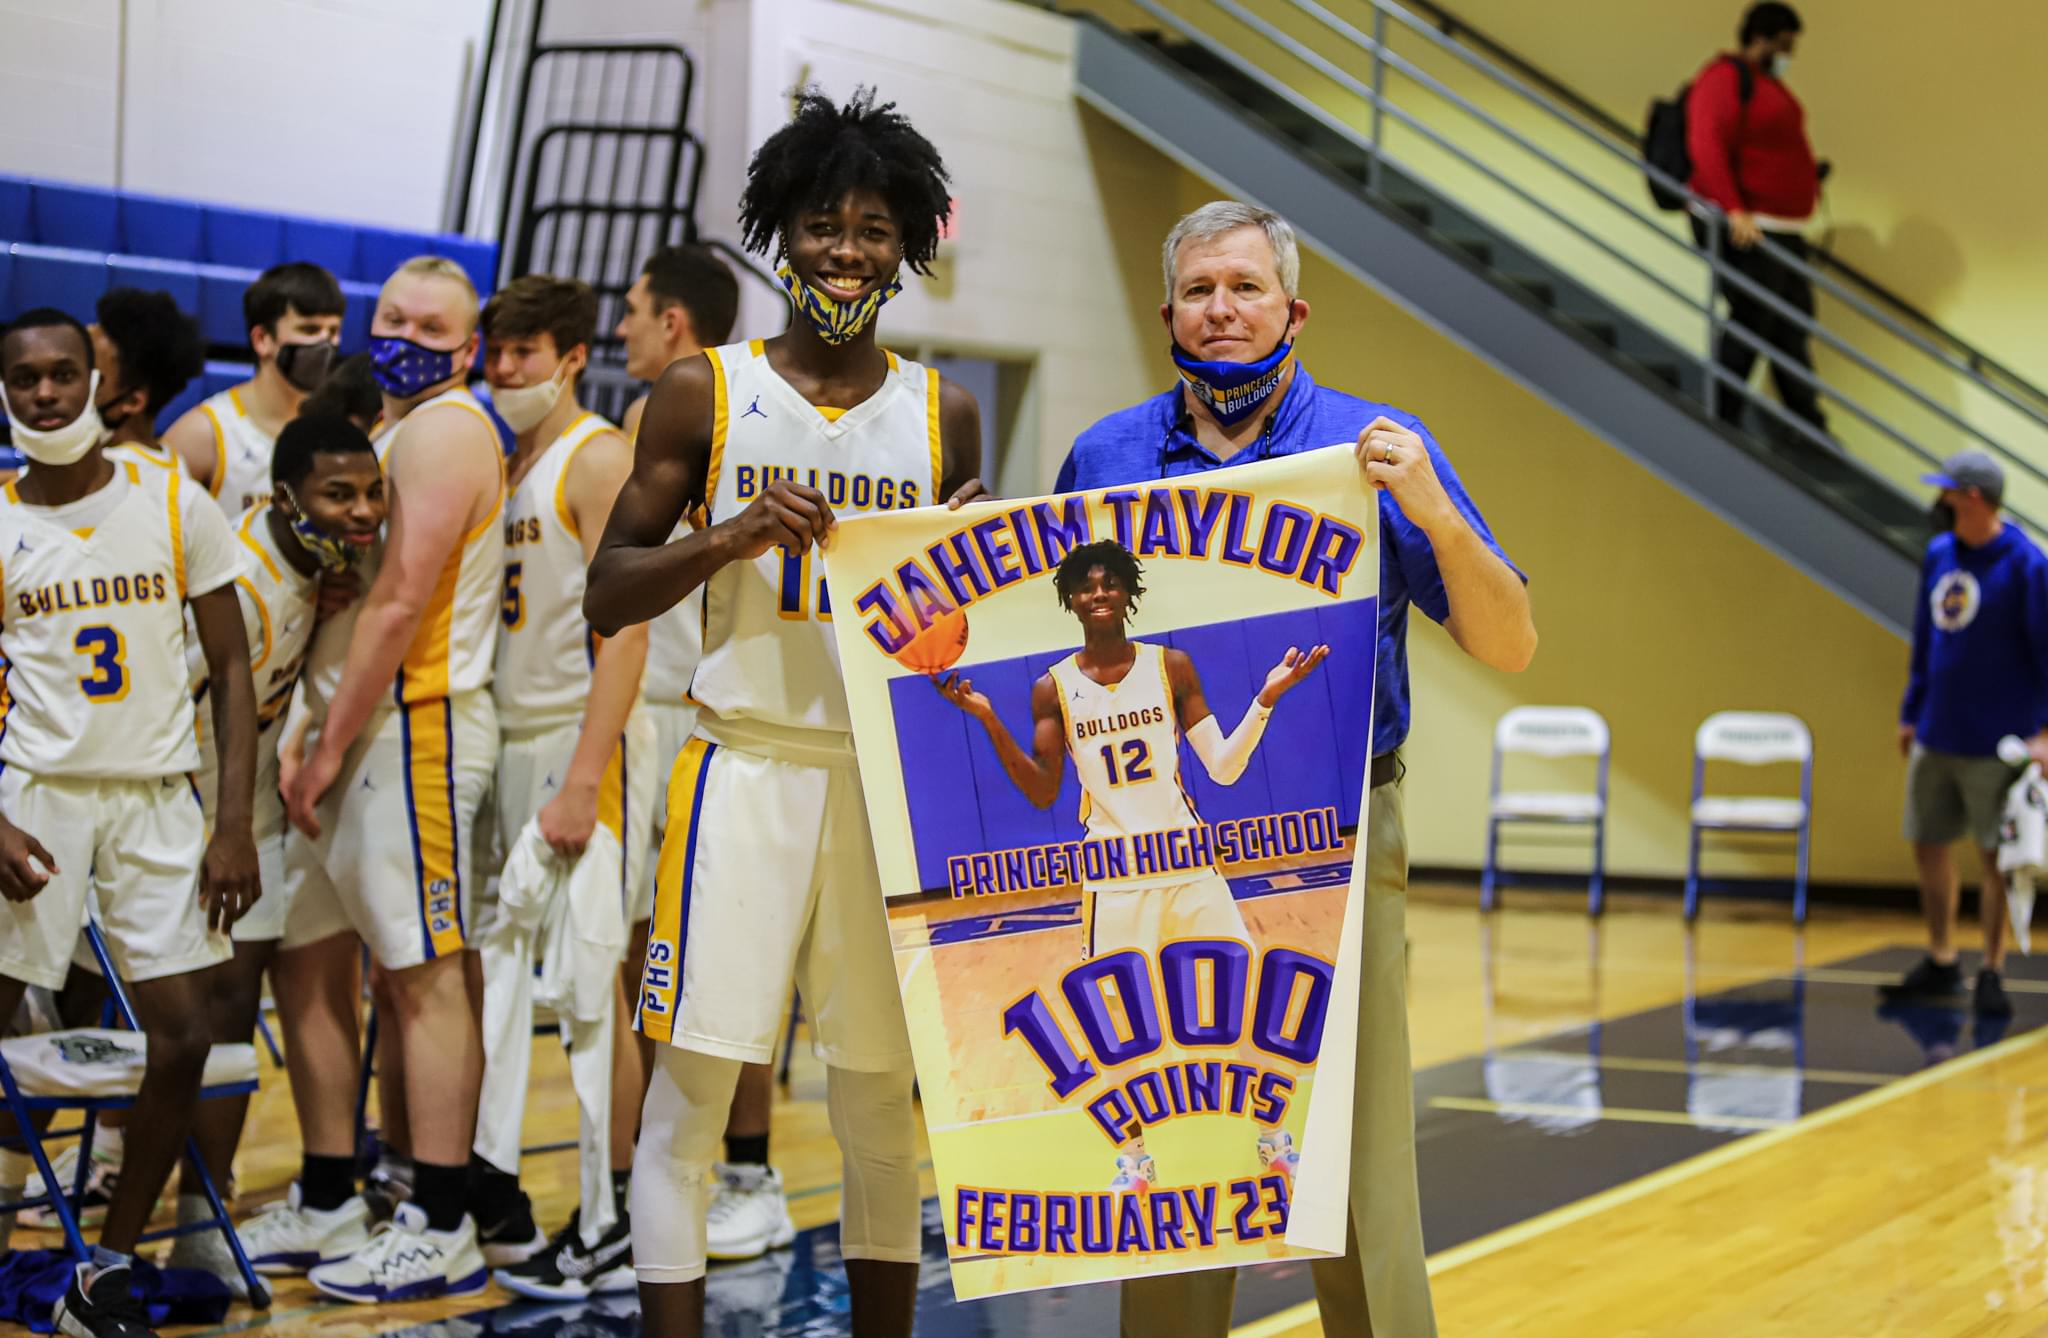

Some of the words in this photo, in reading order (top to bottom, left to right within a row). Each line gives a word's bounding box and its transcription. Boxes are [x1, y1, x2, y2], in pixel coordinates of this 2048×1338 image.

[1227, 377, 1279, 414] BULLDOGS
[18, 572, 166, 619] BULLDOGS
[776, 542, 834, 623] 1
[854, 491, 1094, 657] JAHEIM
[1100, 485, 1365, 600] TAYLOR
[73, 620, 131, 704] 3
[1075, 706, 1164, 741] BULLDOGS
[1100, 738, 1157, 789] 12
[947, 835, 1131, 900] PRINCETON
[1131, 823, 1218, 877] HIGH
[1217, 806, 1346, 864] SCHOOL
[428, 878, 452, 933] PHS
[645, 939, 674, 1014] PHS
[1001, 936, 1335, 1103] 1000
[1084, 1059, 1296, 1149] POINTS
[955, 1180, 1219, 1258] FEBRUARY
[1227, 1173, 1292, 1245] 23
